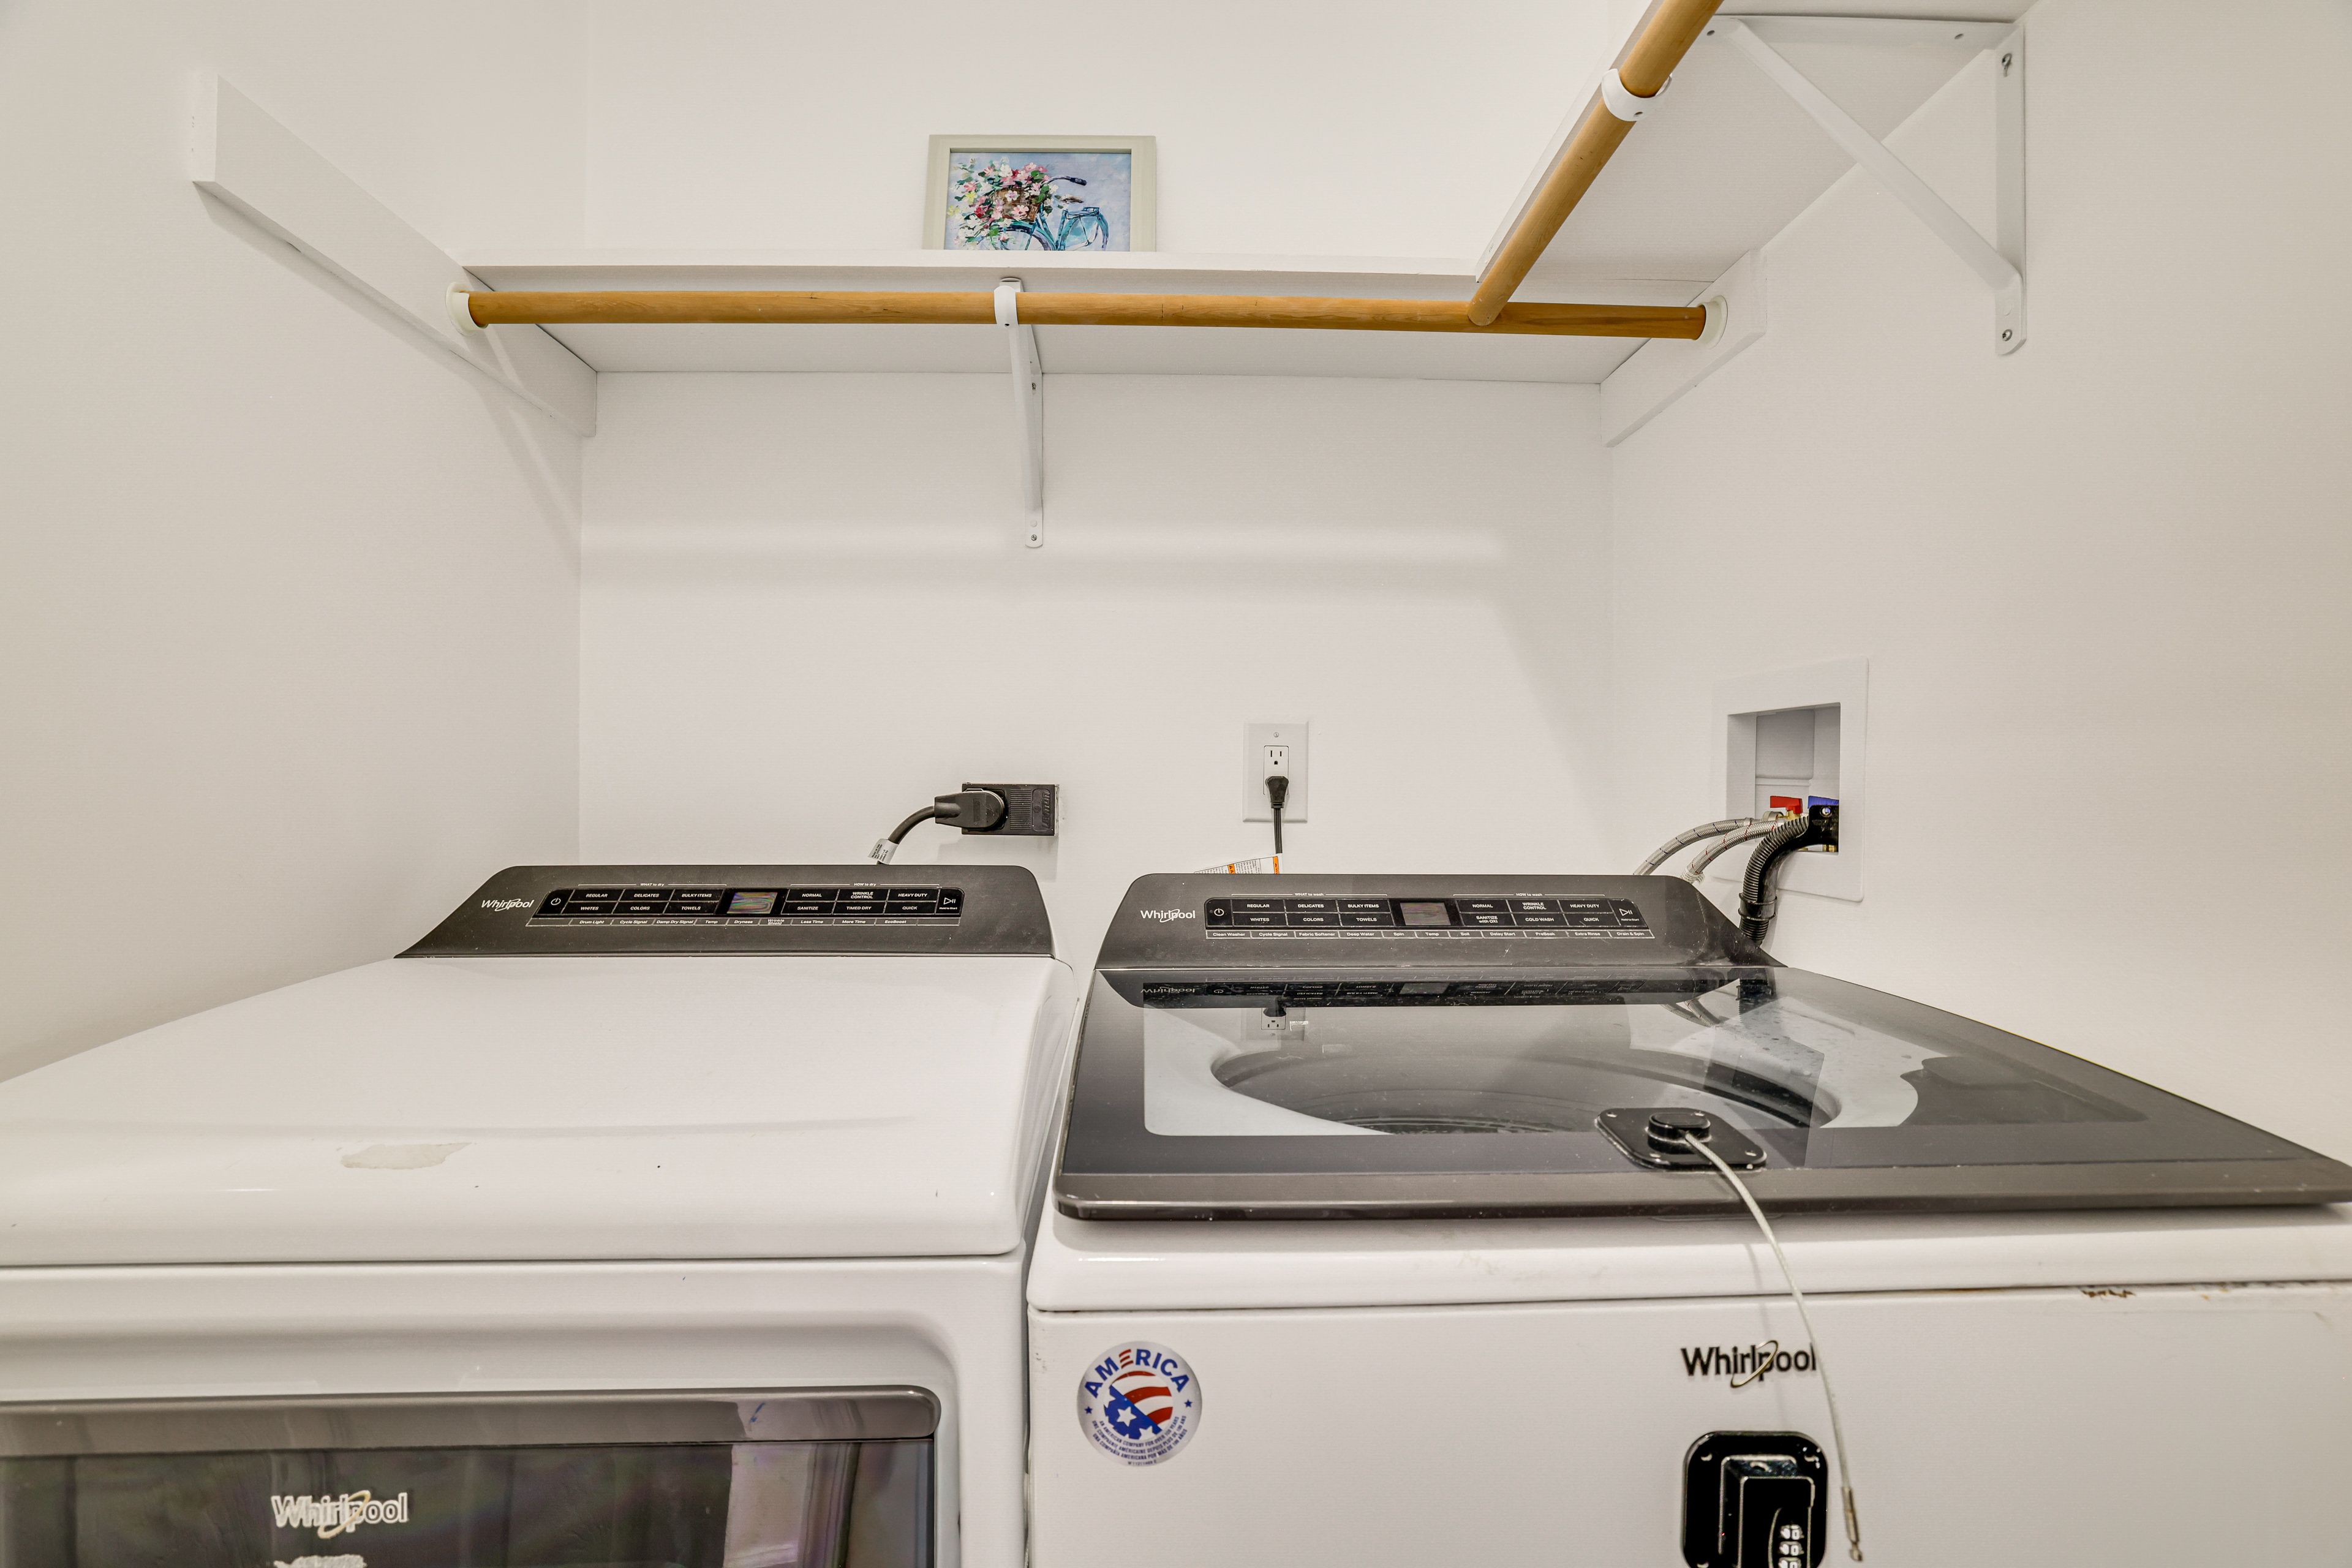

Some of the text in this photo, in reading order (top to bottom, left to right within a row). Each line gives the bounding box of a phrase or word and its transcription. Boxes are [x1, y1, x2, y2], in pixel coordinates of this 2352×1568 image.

[481, 899, 535, 911] Whirlpool
[1140, 908, 1196, 923] Whirlpool
[1085, 1348, 1189, 1399] AMERICA
[1681, 1340, 1817, 1388] Whirlpool
[1103, 1427, 1122, 1443] AMERICAN
[1154, 1434, 1165, 1444] OVER
[1170, 1416, 1180, 1429] YEARS
[1147, 1444, 1163, 1453] DEPUIS
[1163, 1437, 1173, 1446] PLUS
[271, 1490, 409, 1539] Whirlpool
